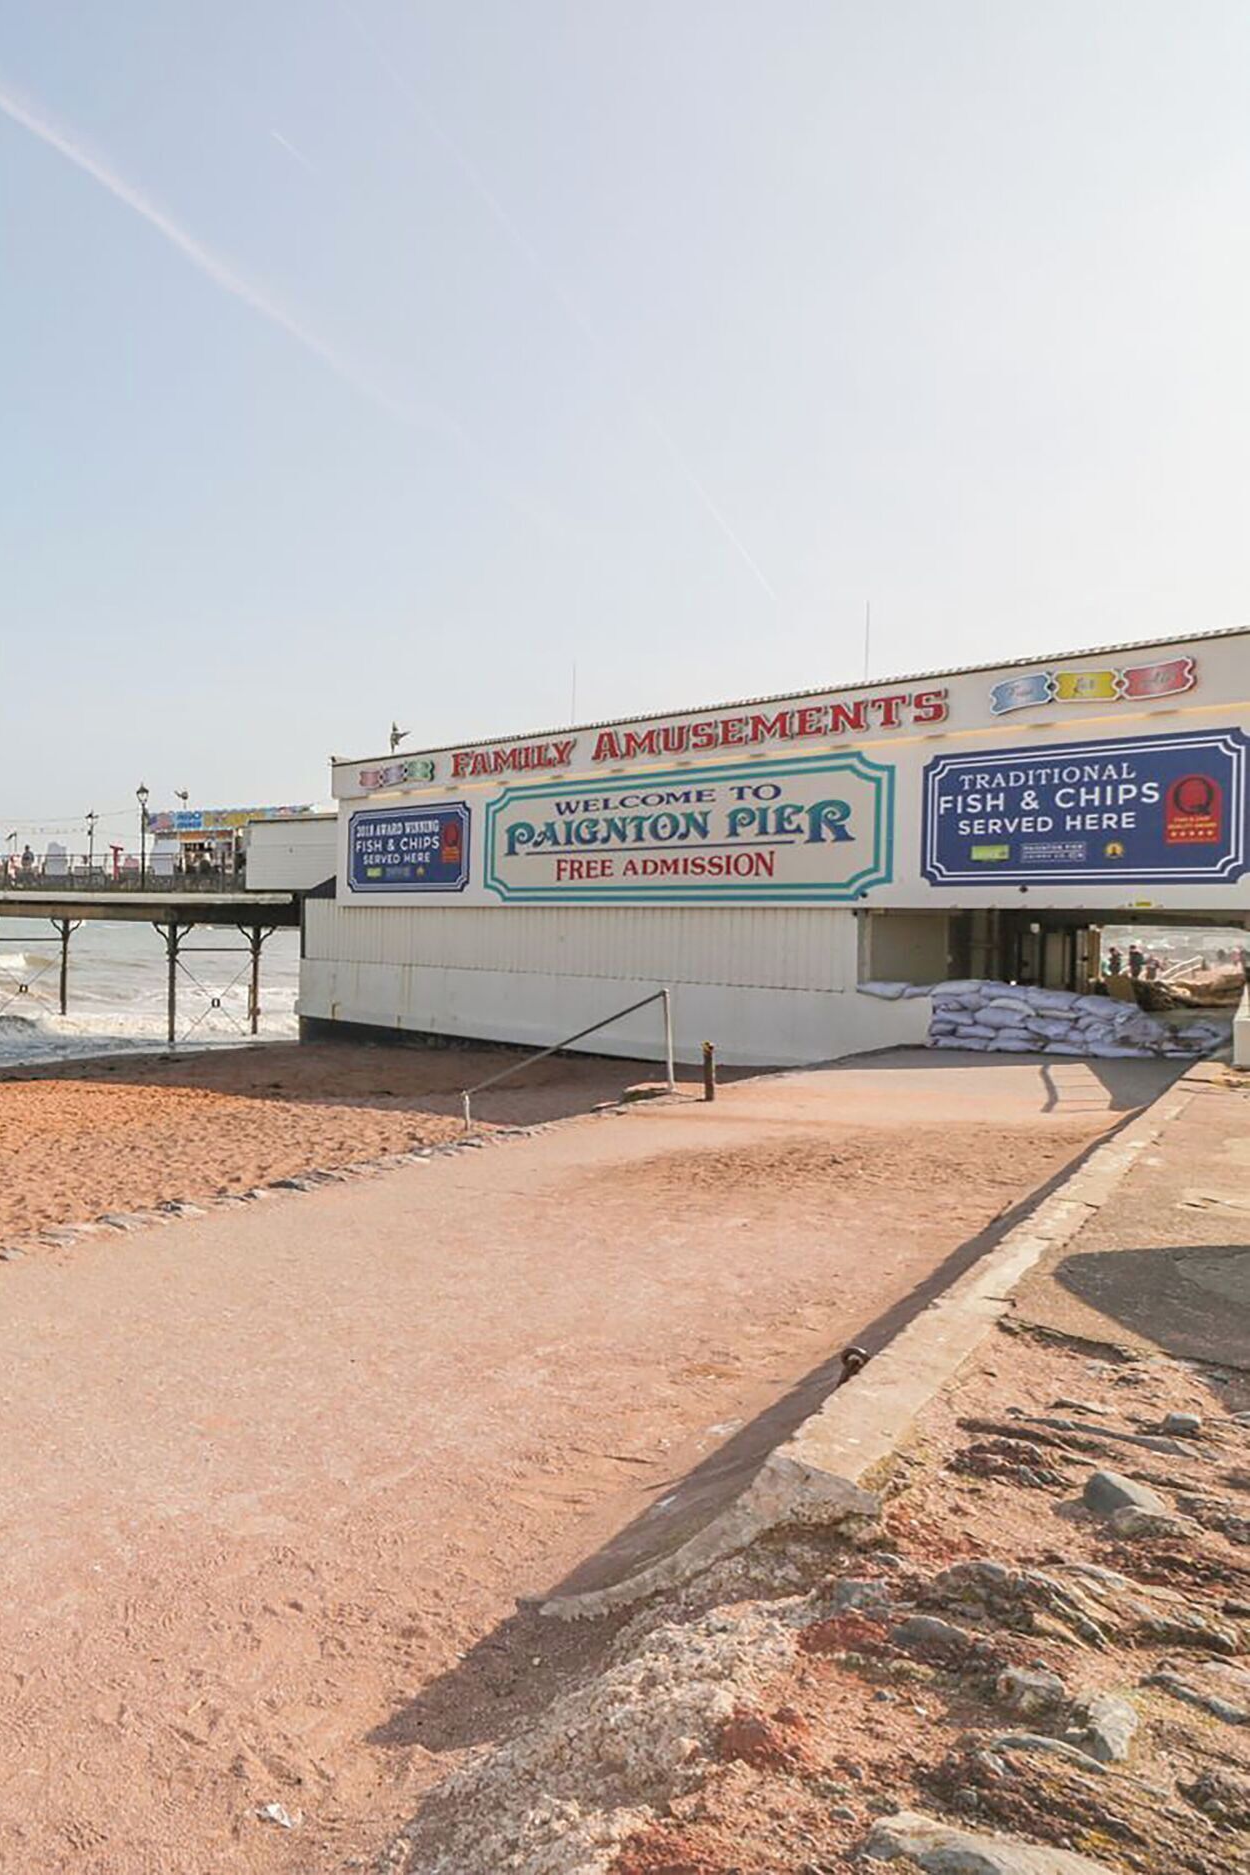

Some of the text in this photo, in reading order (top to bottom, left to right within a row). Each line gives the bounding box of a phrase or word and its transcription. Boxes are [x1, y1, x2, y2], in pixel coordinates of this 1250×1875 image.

[451, 689, 948, 778] FAMILY AMUSEMENTS
[958, 763, 1136, 790] TRADITIONAL
[554, 784, 782, 816] WELCOME TO
[939, 782, 1160, 815] FISH & CHIPS
[504, 800, 856, 857] PAIGNTON PIER
[958, 812, 1136, 836] SERVED HERE
[356, 836, 440, 853] FISH & CHIPS
[363, 853, 401, 865] SERVED
[403, 852, 431, 864] HERE
[555, 851, 776, 881] FREE ADMISSION
